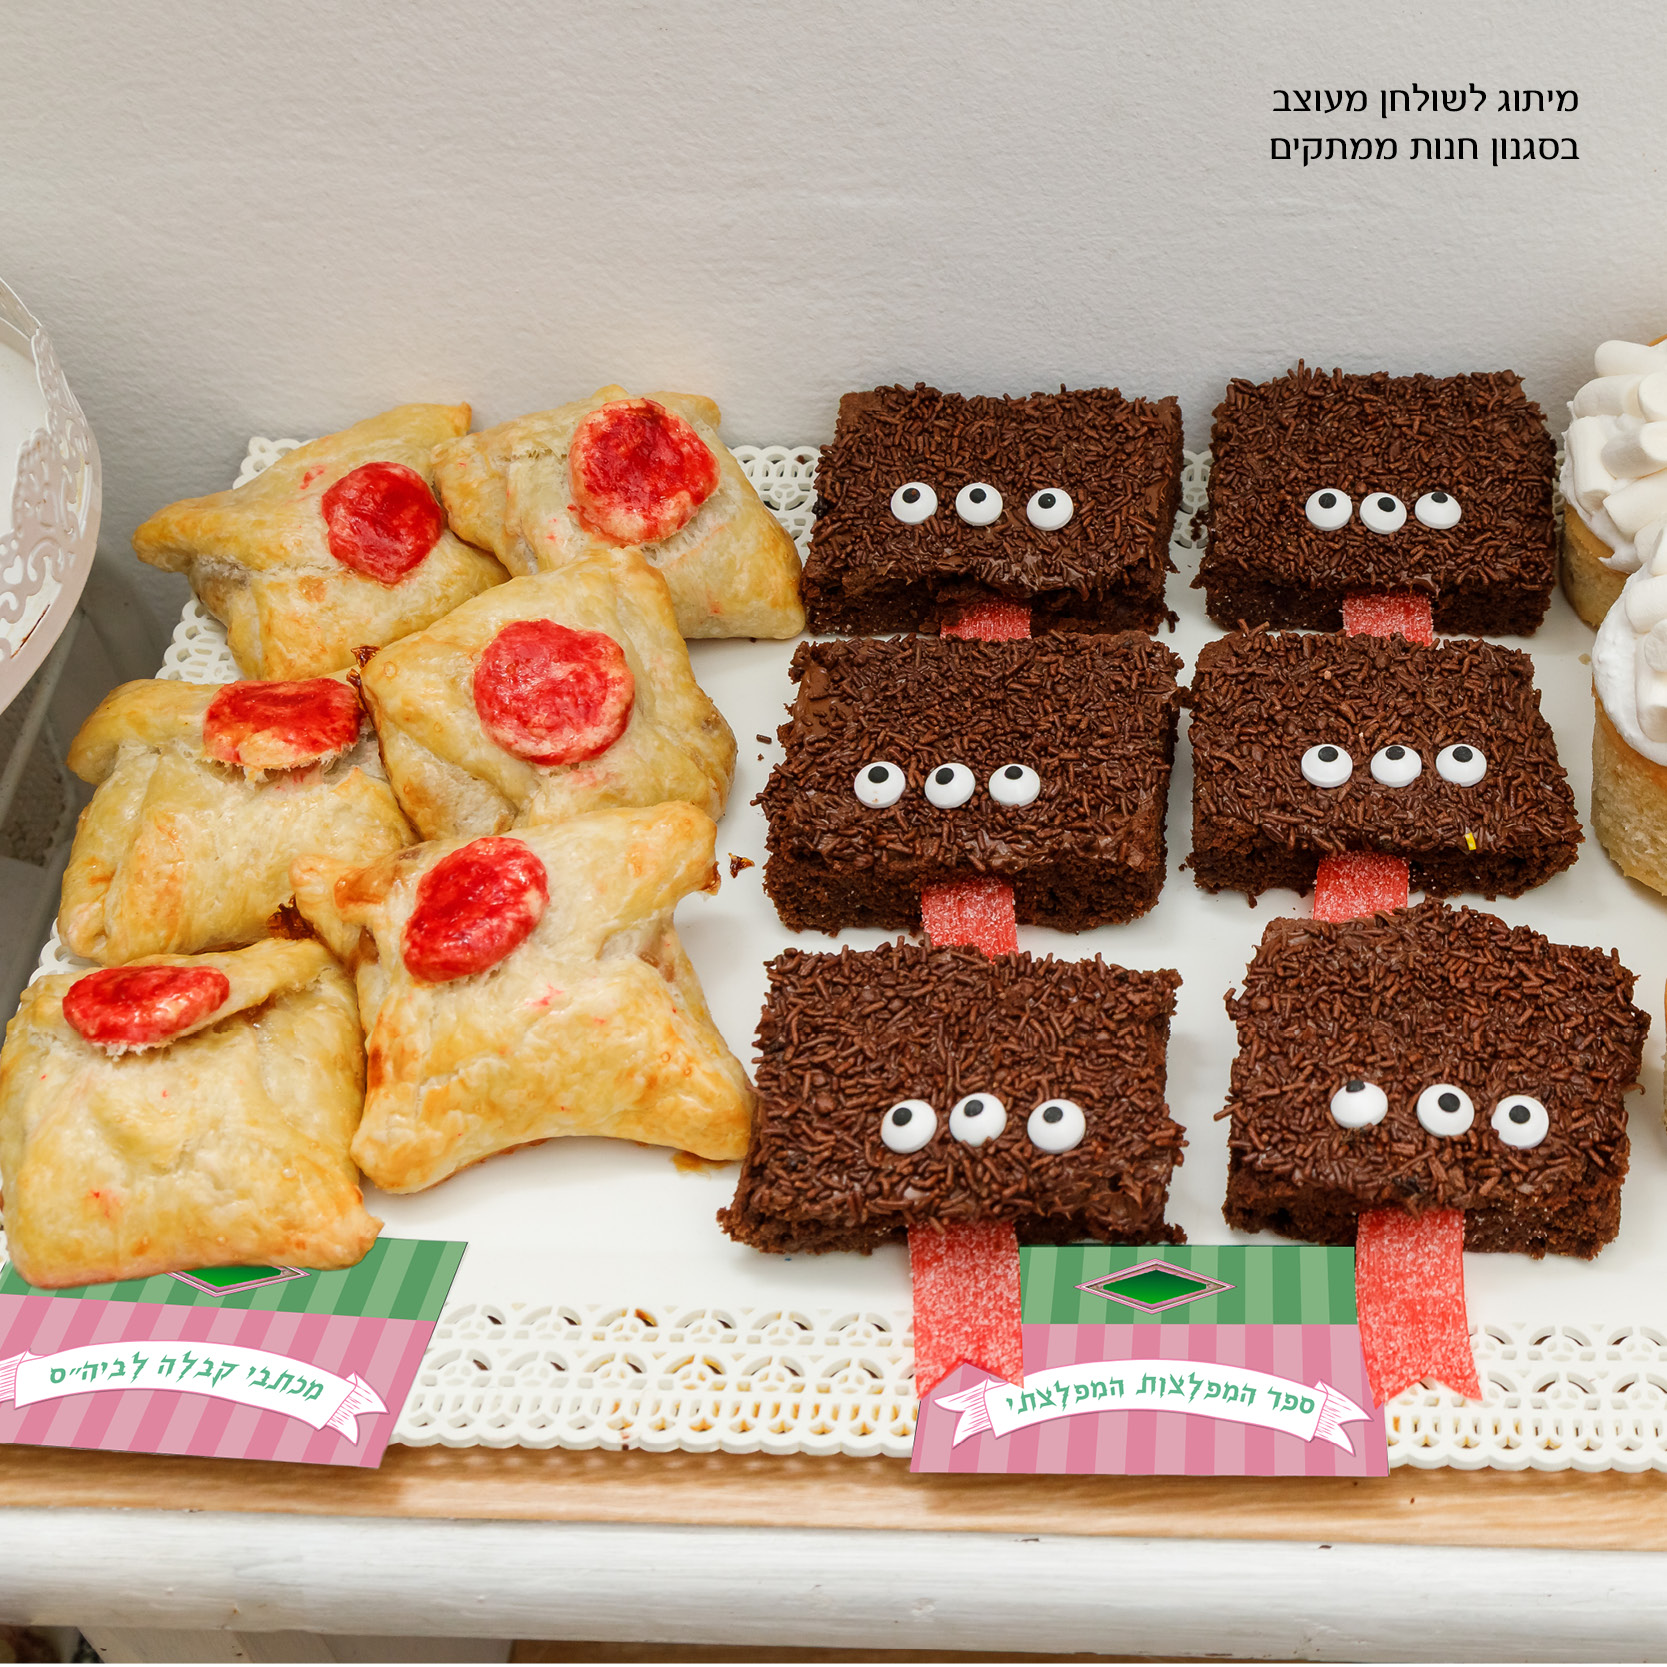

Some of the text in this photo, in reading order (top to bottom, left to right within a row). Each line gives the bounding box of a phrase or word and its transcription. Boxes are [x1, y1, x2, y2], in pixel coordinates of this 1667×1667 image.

[157, 1350, 241, 1388] קבלה
[247, 1365, 324, 1401] מכתבי
[1005, 1371, 1315, 1415] ספר המפלצות המפלצתי
